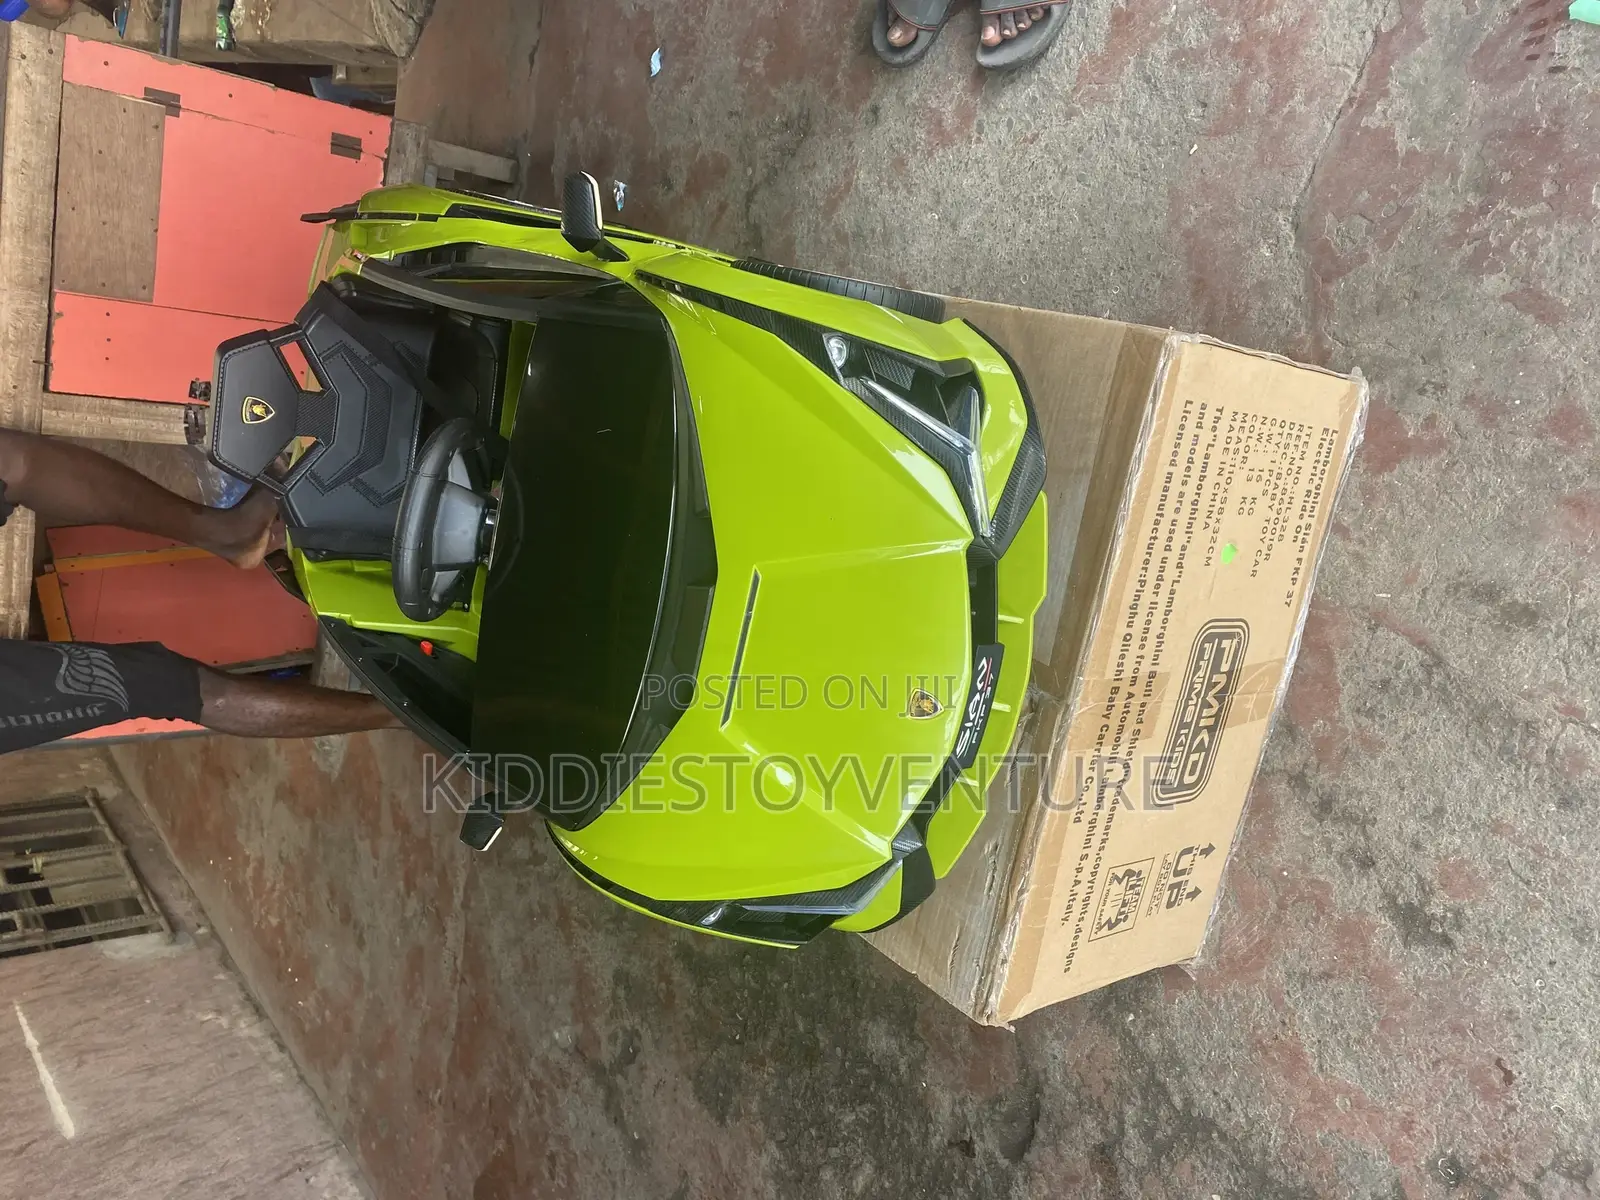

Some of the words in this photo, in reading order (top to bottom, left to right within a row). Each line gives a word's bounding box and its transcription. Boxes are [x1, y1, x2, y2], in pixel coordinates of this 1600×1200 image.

[1168, 398, 1194, 467] Licensed
[1194, 402, 1209, 429] and
[1221, 411, 1239, 455] MADE
[1237, 413, 1259, 470] COLOR:
[1252, 415, 1268, 453] N.W.:
[1261, 417, 1277, 453] G.W.:
[1272, 419, 1287, 453] QTY:
[1298, 425, 1313, 460] ITEM
[1180, 433, 1201, 486] models
[1216, 460, 1226, 476] IN
[1265, 421, 1297, 511] DESC.:BABY
[1307, 427, 1329, 484] Electric
[1245, 467, 1255, 482] 13
[1254, 467, 1265, 483] 16
[1260, 468, 1274, 497] PCS
[1305, 429, 1338, 518] Lamborghini
[1172, 490, 1186, 515] are
[1201, 481, 1221, 530] CHINA
[1236, 496, 1248, 516] KG
[1246, 496, 1257, 516] KG
[1297, 489, 1312, 520] Ride
[1163, 518, 1180, 552] used
[1257, 518, 1271, 544] TOY
[1291, 524, 1302, 543] On
[1151, 556, 1170, 597] under
[1249, 549, 1263, 578] CAR
[1288, 557, 1303, 585] FKP
[1282, 590, 1294, 607] 37
[1137, 601, 1158, 650] license
[1111, 632, 1134, 681] Qileshi
[1128, 654, 1145, 686] from
[1142, 671, 1157, 697] Bull
[1100, 685, 1120, 719] Baby
[1134, 701, 1149, 723] and
[1107, 691, 1135, 764] Automobili
[1087, 723, 1110, 772] Carrier
[1163, 729, 1188, 785] KIDS
[1081, 768, 1112, 849] Lamborghini
[1186, 844, 1200, 875] THIS
[1126, 877, 1144, 913] TEAM
[1161, 846, 1194, 910] UP
[1176, 879, 1189, 906] END
[1101, 888, 1110, 907] YOUR
[1116, 877, 1137, 919] LIFT
[1153, 883, 1165, 908] NOT
[1093, 908, 1104, 935] SAFETY
